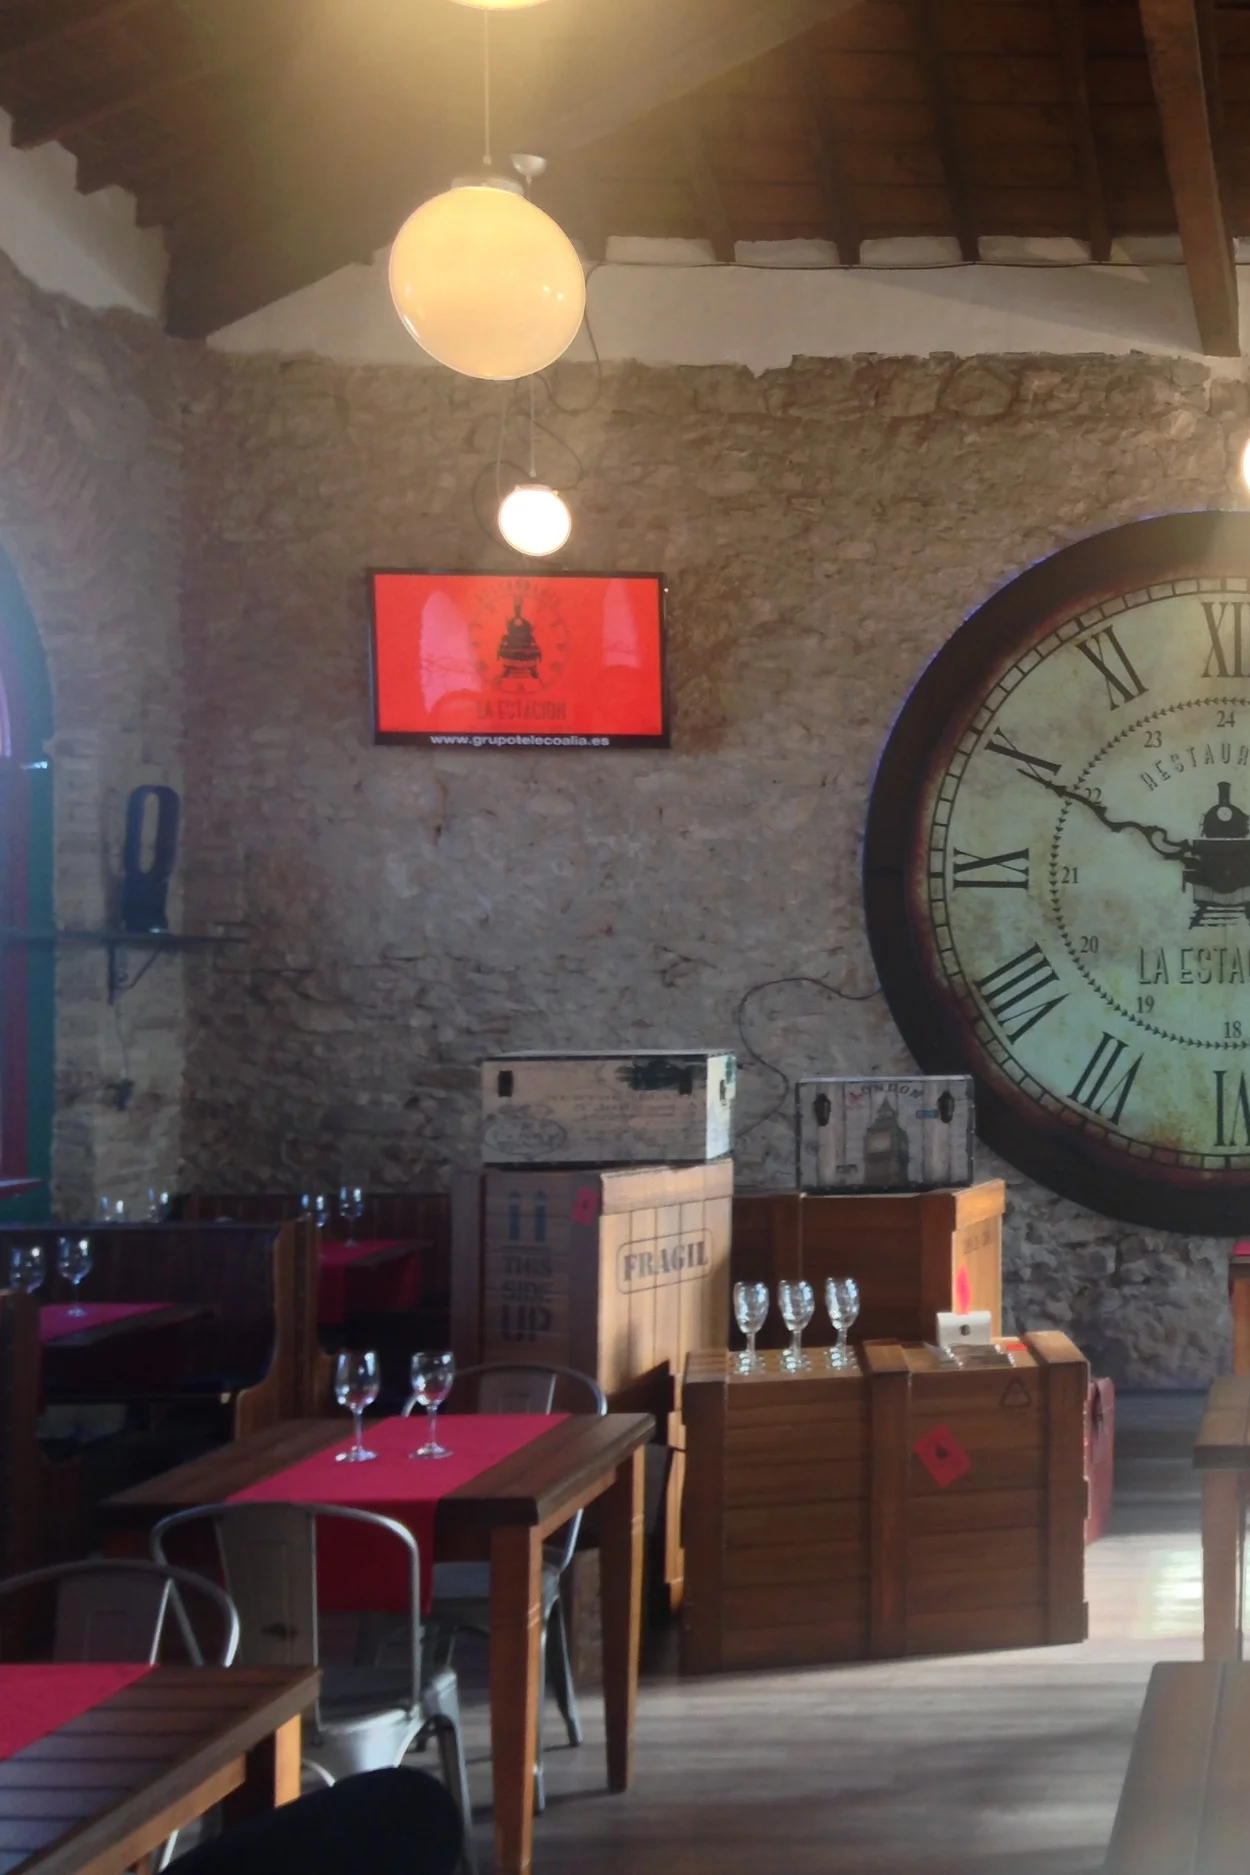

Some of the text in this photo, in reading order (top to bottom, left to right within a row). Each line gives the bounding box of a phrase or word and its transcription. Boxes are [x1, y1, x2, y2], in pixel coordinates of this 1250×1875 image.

[1076, 625, 1149, 711] XI
[1216, 710, 1235, 728] 24
[429, 735, 610, 747] www.grupotelecoalia.es
[1143, 730, 1163, 748] 23
[953, 848, 1030, 890] IX
[1060, 866, 1080, 884] 21
[1080, 935, 1099, 953] 20
[1138, 947, 1169, 984] LA
[973, 941, 1071, 1045] VIII
[1136, 995, 1155, 1014] 19
[1223, 1021, 1242, 1039] 18
[1067, 1031, 1145, 1125] VII
[623, 1241, 709, 1281] FRAGIL
[501, 1304, 552, 1342] UP
